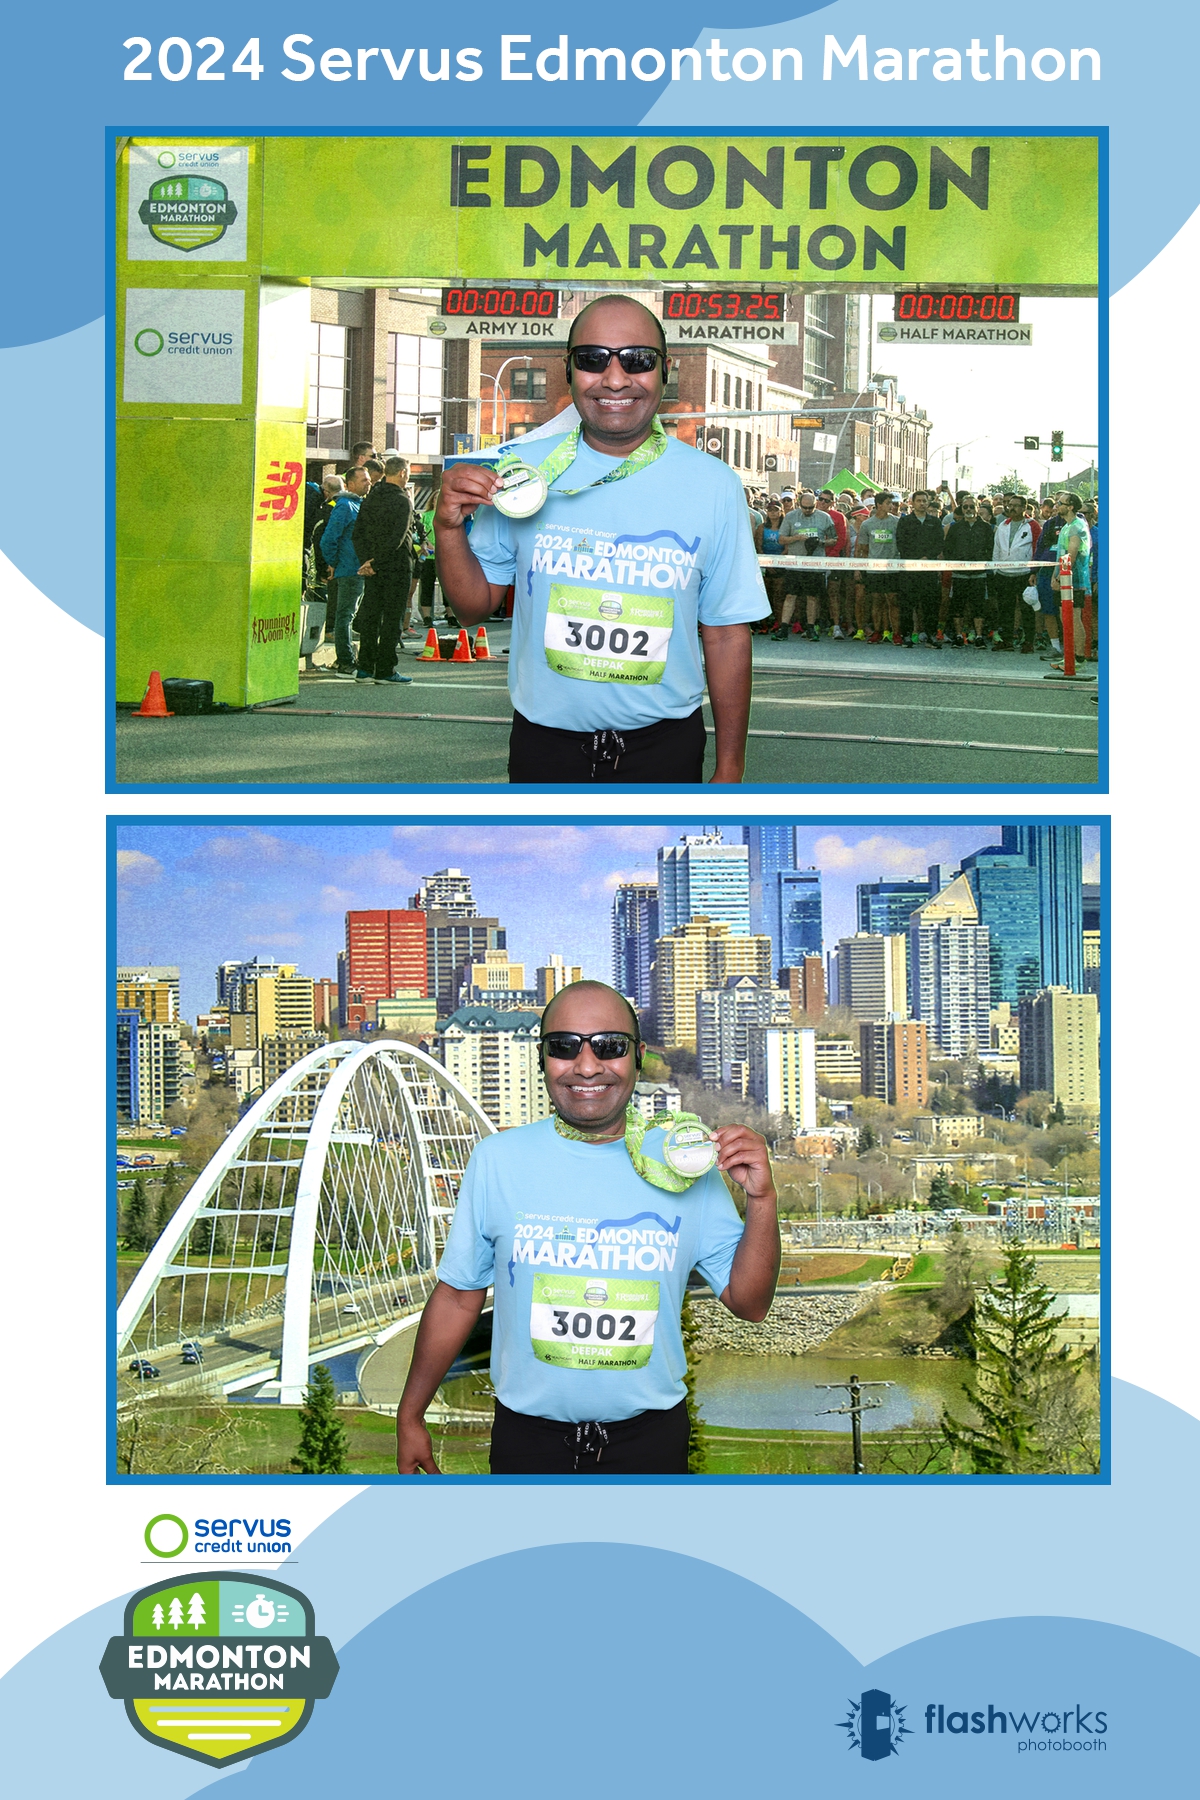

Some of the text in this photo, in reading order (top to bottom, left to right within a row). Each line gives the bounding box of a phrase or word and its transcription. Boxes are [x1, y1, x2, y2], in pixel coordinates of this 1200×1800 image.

[178, 152, 219, 161] servus
[450, 144, 991, 211] EDMONTON
[149, 203, 227, 214] EDMONTON
[160, 214, 215, 222] MARATHON
[523, 223, 906, 271] MARATHON
[465, 321, 555, 336] ARMY 10K
[678, 325, 785, 340] MARATHON
[900, 328, 939, 340] HALF
[942, 328, 1031, 341] MARATHON
[167, 331, 233, 345] servus
[167, 345, 233, 355] credit union
[545, 522, 570, 533] servus
[571, 525, 593, 536] credit
[534, 533, 698, 567] 2024 EDMONTON
[531, 548, 693, 590] MARATHON
[257, 613, 290, 637] Running
[565, 620, 649, 656] 3002
[583, 657, 625, 671] DEEPAK
[589, 670, 607, 678] HALF
[608, 673, 649, 681] MARATHON
[524, 1213, 550, 1221] servus
[551, 1215, 574, 1223] credit
[514, 1224, 679, 1248] 2024 EDMONTON
[512, 1239, 677, 1272] MARATHON
[551, 1310, 636, 1341] 3002
[571, 1346, 613, 1357] DEEPAK
[578, 1358, 596, 1366] HALF
